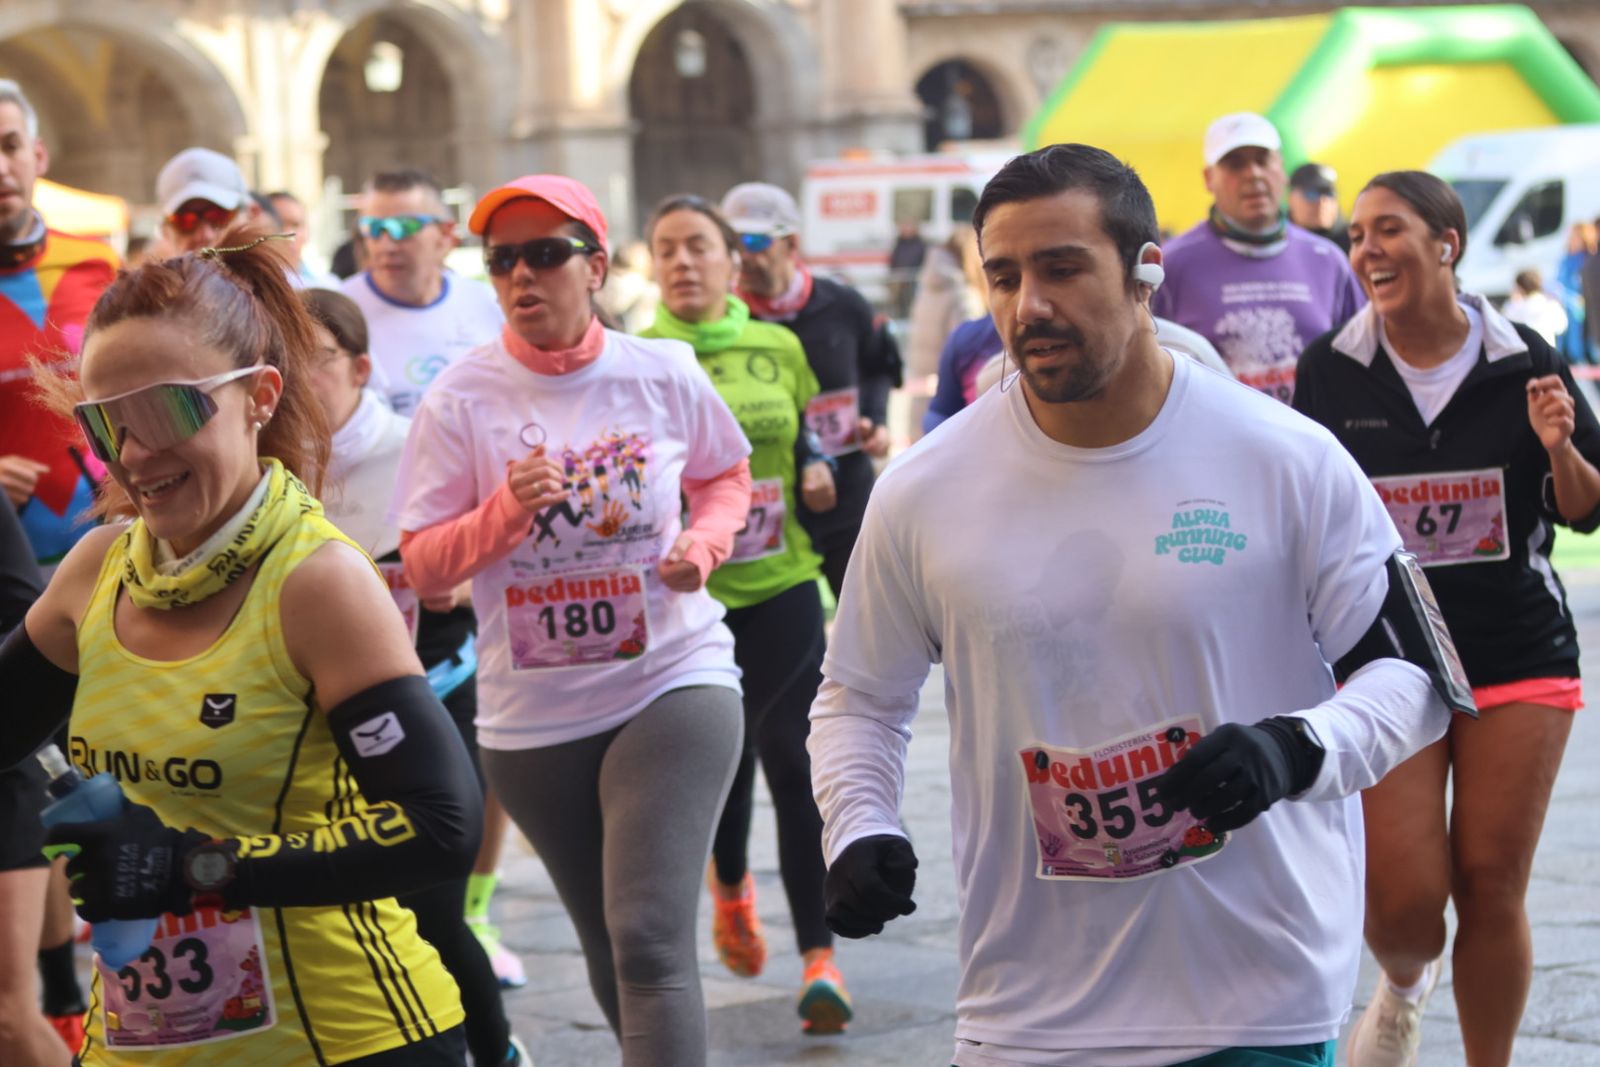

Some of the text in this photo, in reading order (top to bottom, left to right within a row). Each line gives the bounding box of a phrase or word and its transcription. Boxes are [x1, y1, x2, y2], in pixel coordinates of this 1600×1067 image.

[1171, 508, 1230, 529] ALPHA
[1416, 503, 1463, 537] 67
[1177, 546, 1226, 566] CLUB
[504, 572, 641, 608] bedunia
[538, 600, 616, 640] 180
[1064, 775, 1177, 840] 355
